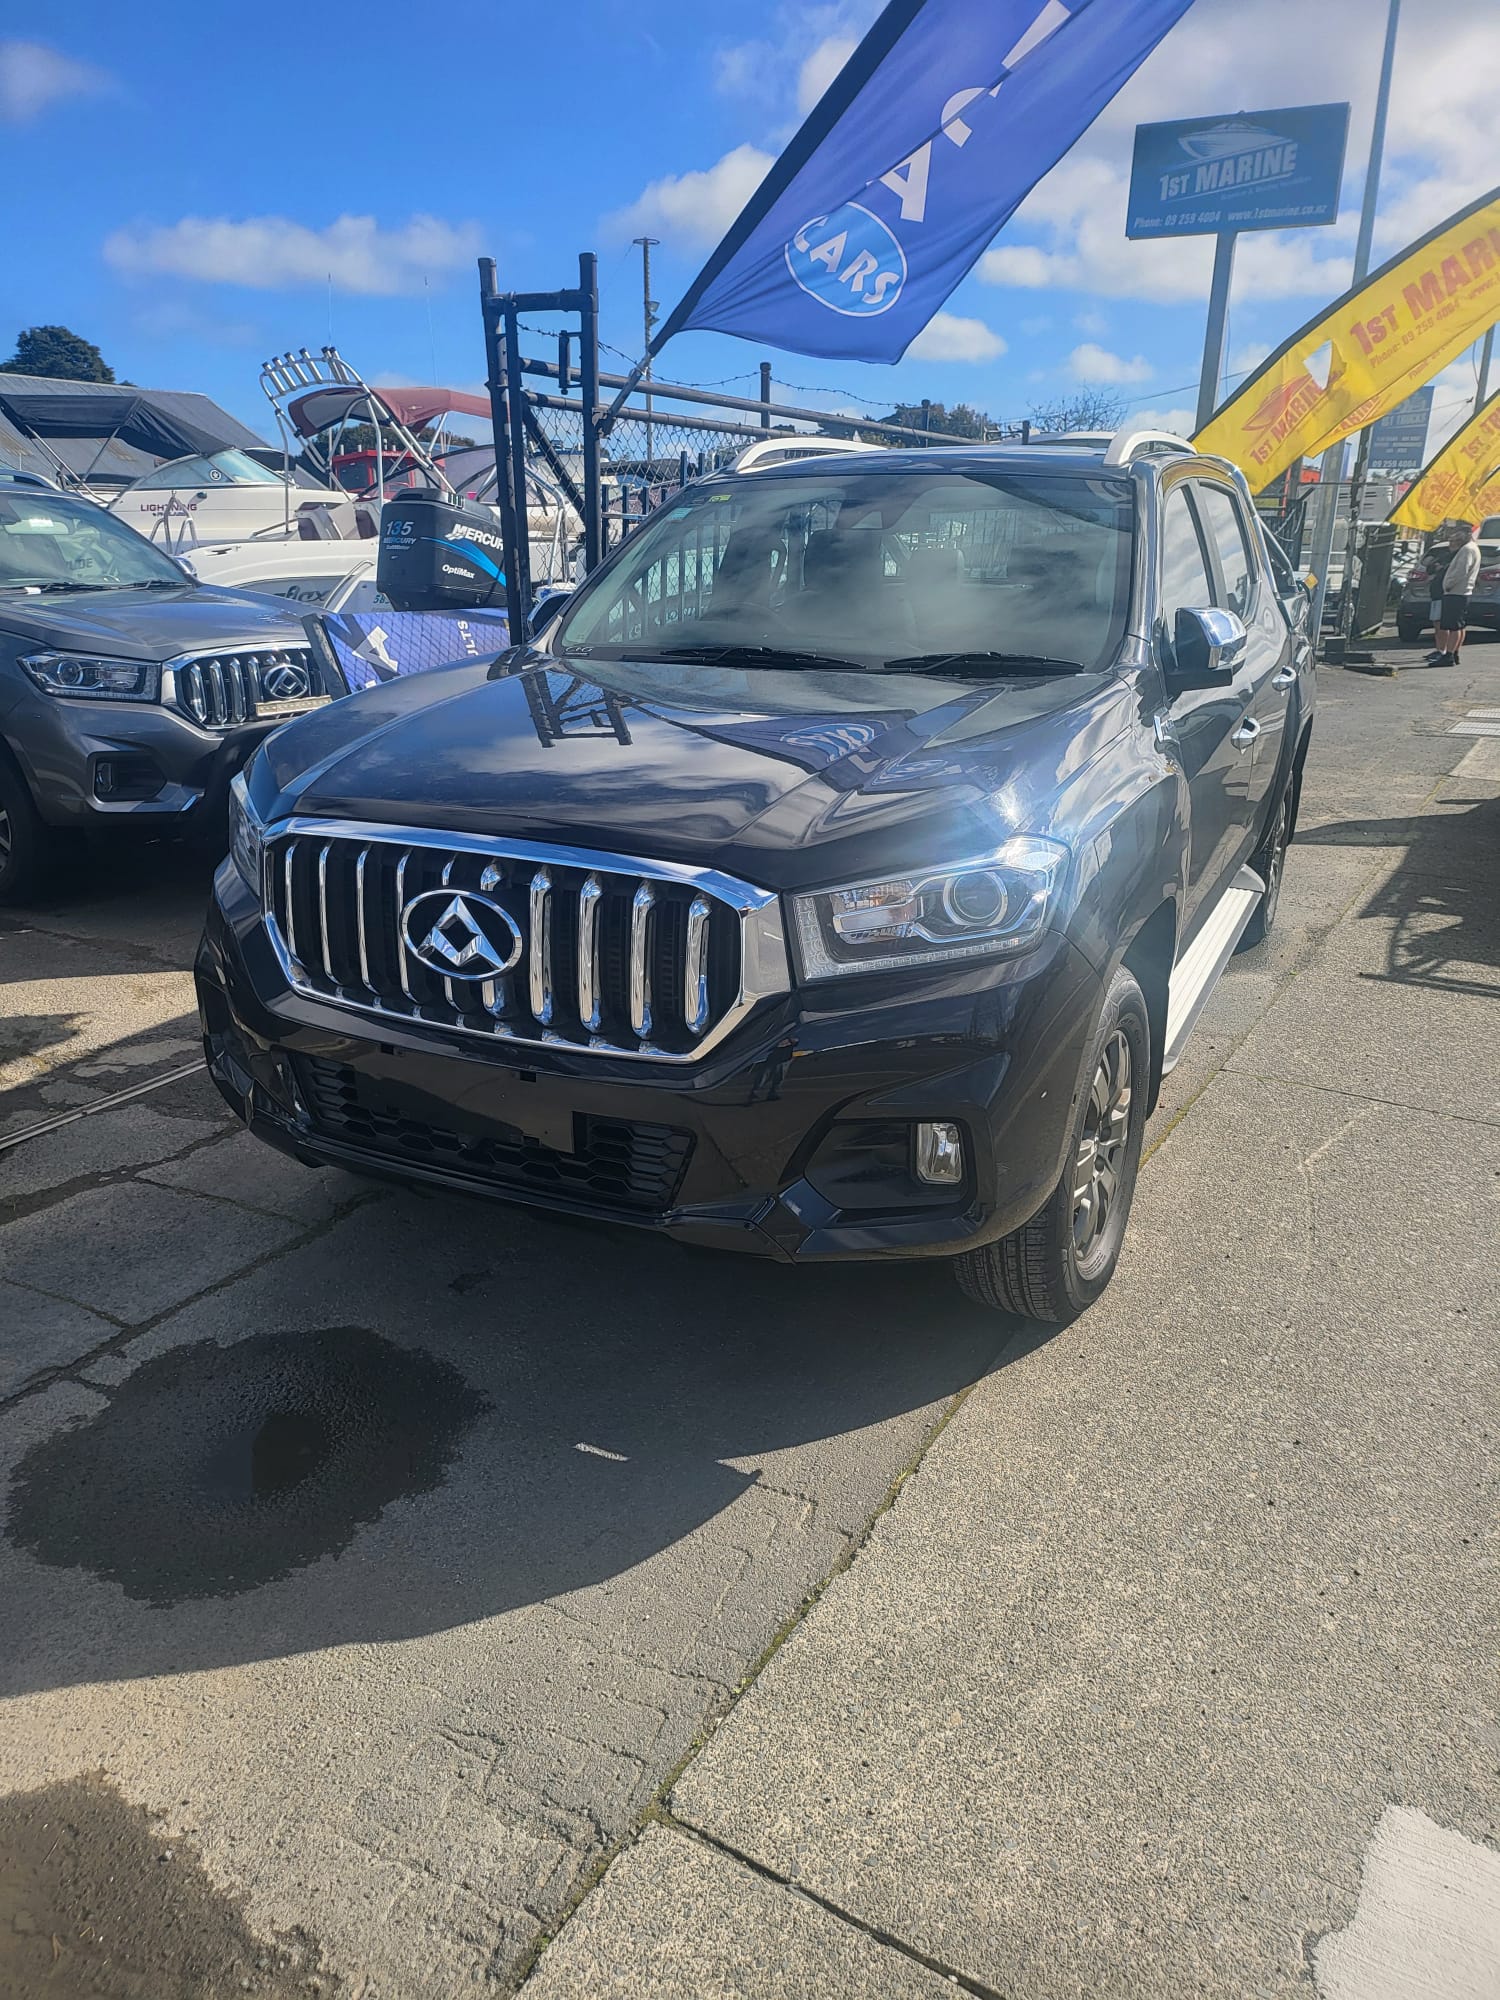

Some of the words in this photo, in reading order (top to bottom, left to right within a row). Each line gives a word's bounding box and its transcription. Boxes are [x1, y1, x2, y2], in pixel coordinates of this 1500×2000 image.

[1195, 143, 1299, 193] MARINE
[1165, 215, 1177, 226] 09
[793, 215, 900, 304] CARS
[1270, 382, 1324, 444] MARIN
[140, 503, 197, 512] LIGHNNG
[386, 521, 414, 536] 135
[383, 536, 416, 544] MERCURY
[445, 523, 504, 551] MERCUR
[442, 564, 475, 579] OptiMax
